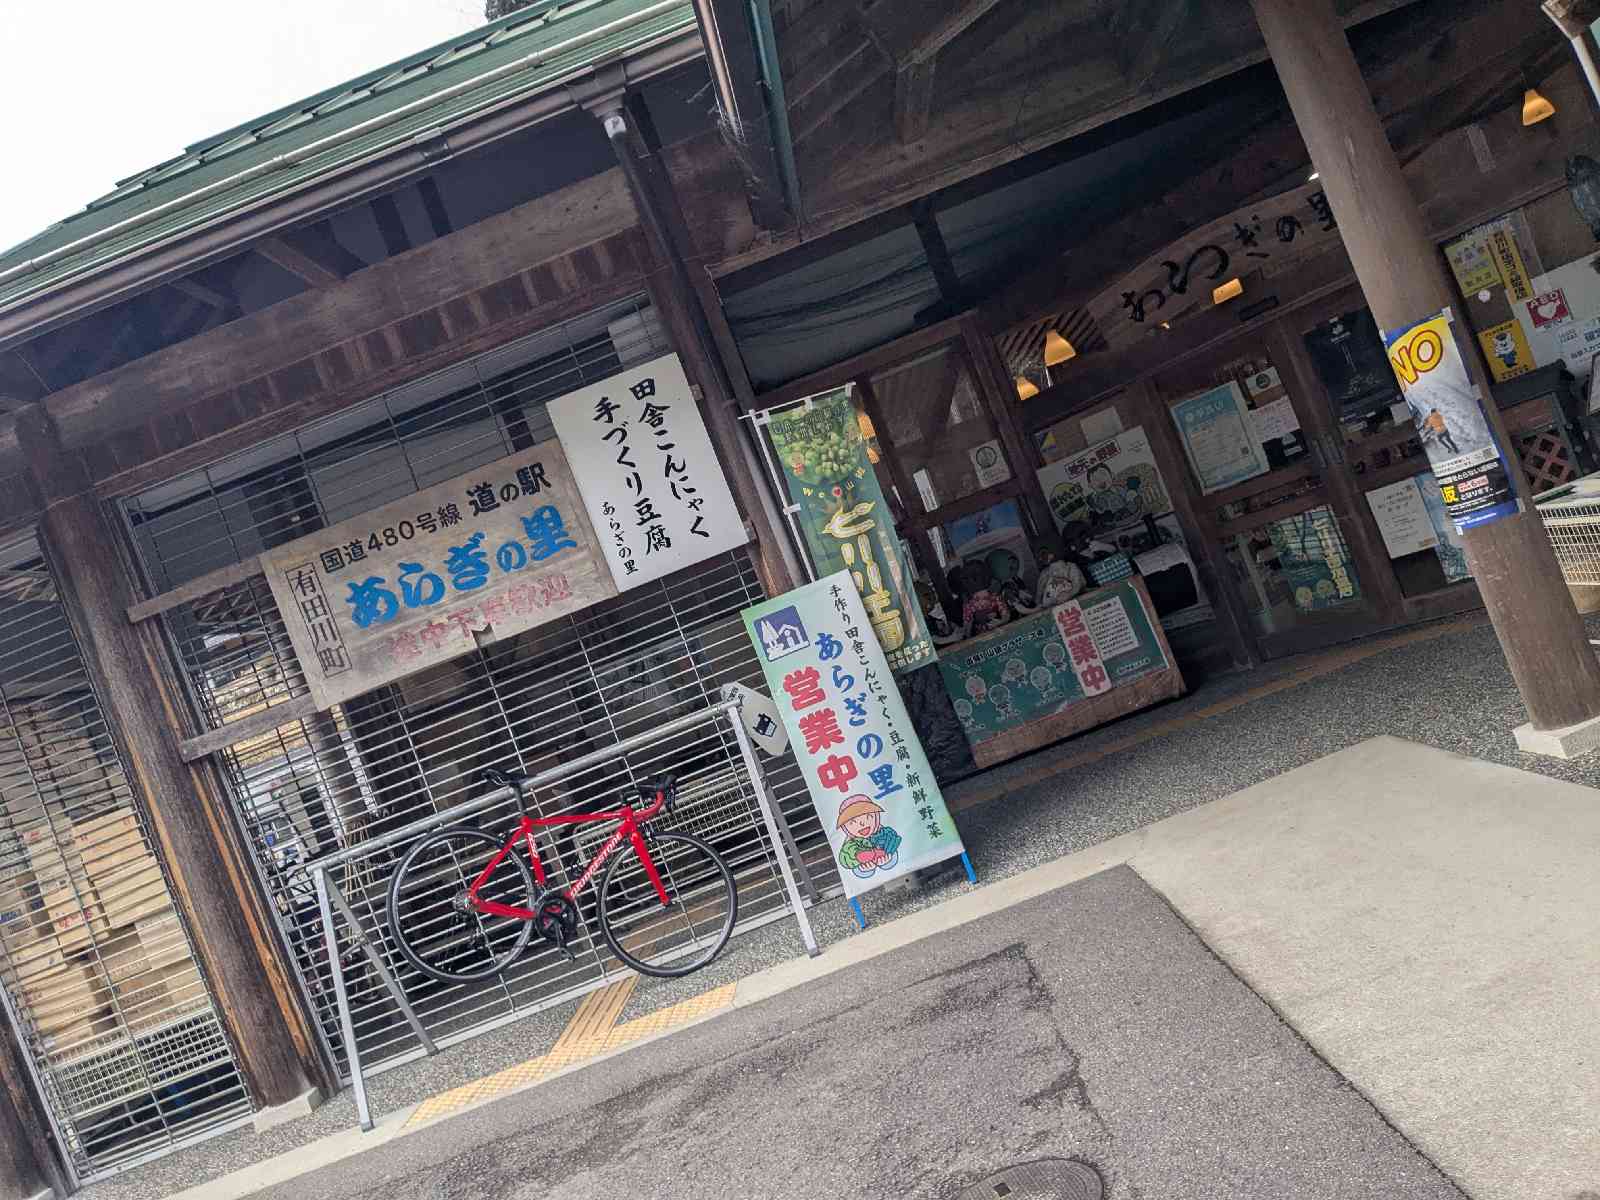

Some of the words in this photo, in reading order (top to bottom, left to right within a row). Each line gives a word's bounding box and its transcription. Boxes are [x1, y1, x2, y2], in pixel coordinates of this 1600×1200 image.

[319, 502, 464, 575] 国道480号線
[466, 461, 552, 517] 道の駅
[593, 396, 672, 555] 手づくり豆腐
[629, 378, 710, 538] 田舎こんにゃく
[292, 568, 352, 673] 有田川町
[345, 505, 578, 630] あらぎの里
[1056, 605, 1107, 691] 営業中
[782, 666, 859, 793] 営業中
[814, 632, 904, 800] あらぎの里
